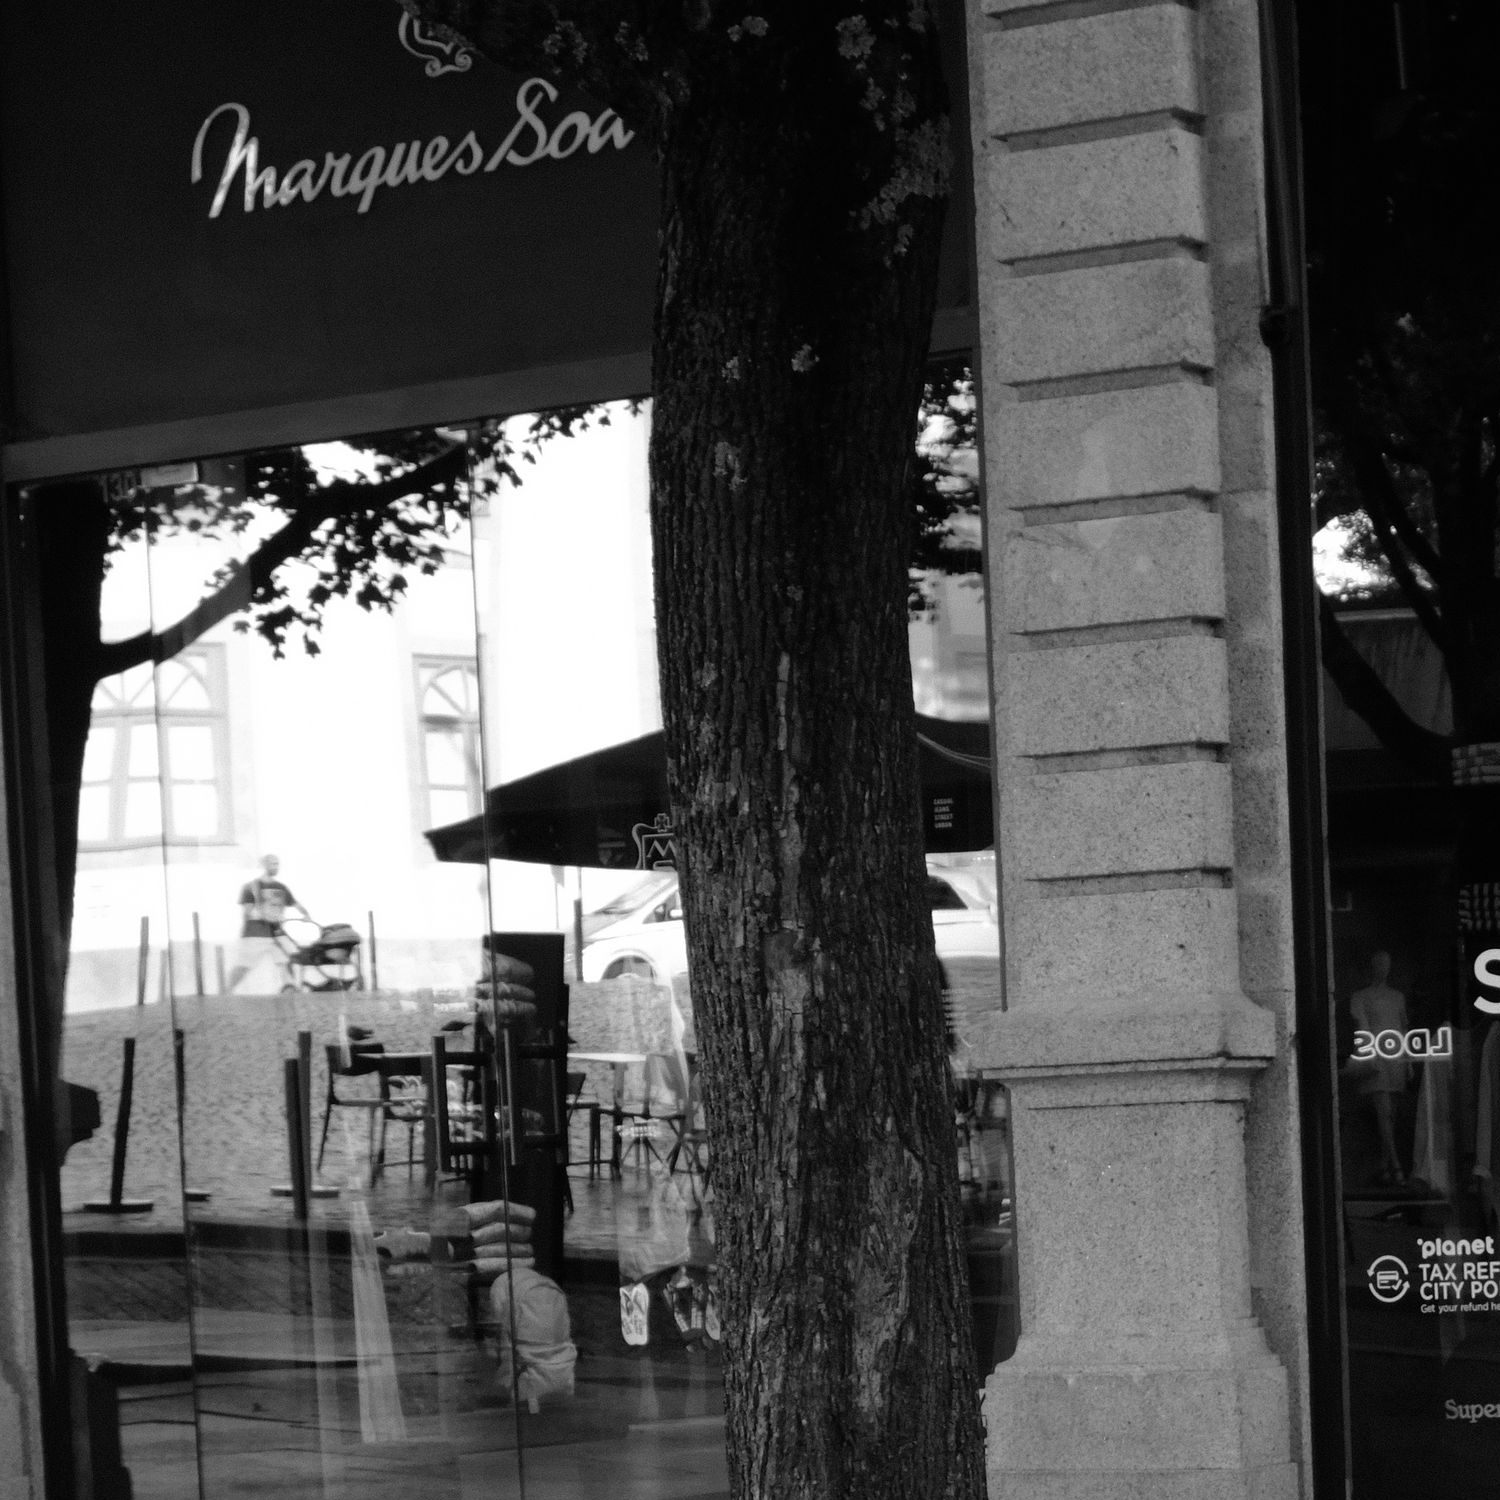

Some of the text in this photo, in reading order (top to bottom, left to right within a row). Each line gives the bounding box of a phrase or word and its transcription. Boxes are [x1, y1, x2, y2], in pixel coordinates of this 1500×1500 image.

[191, 103, 485, 218] Marques
[1419, 1236, 1495, 1259] planet
[1418, 1263, 1457, 1282] TAX
[1420, 1281, 1464, 1300] CITY
[1420, 1303, 1436, 1314] Get
[1438, 1305, 1458, 1315] your
[1460, 1303, 1489, 1313] refund
